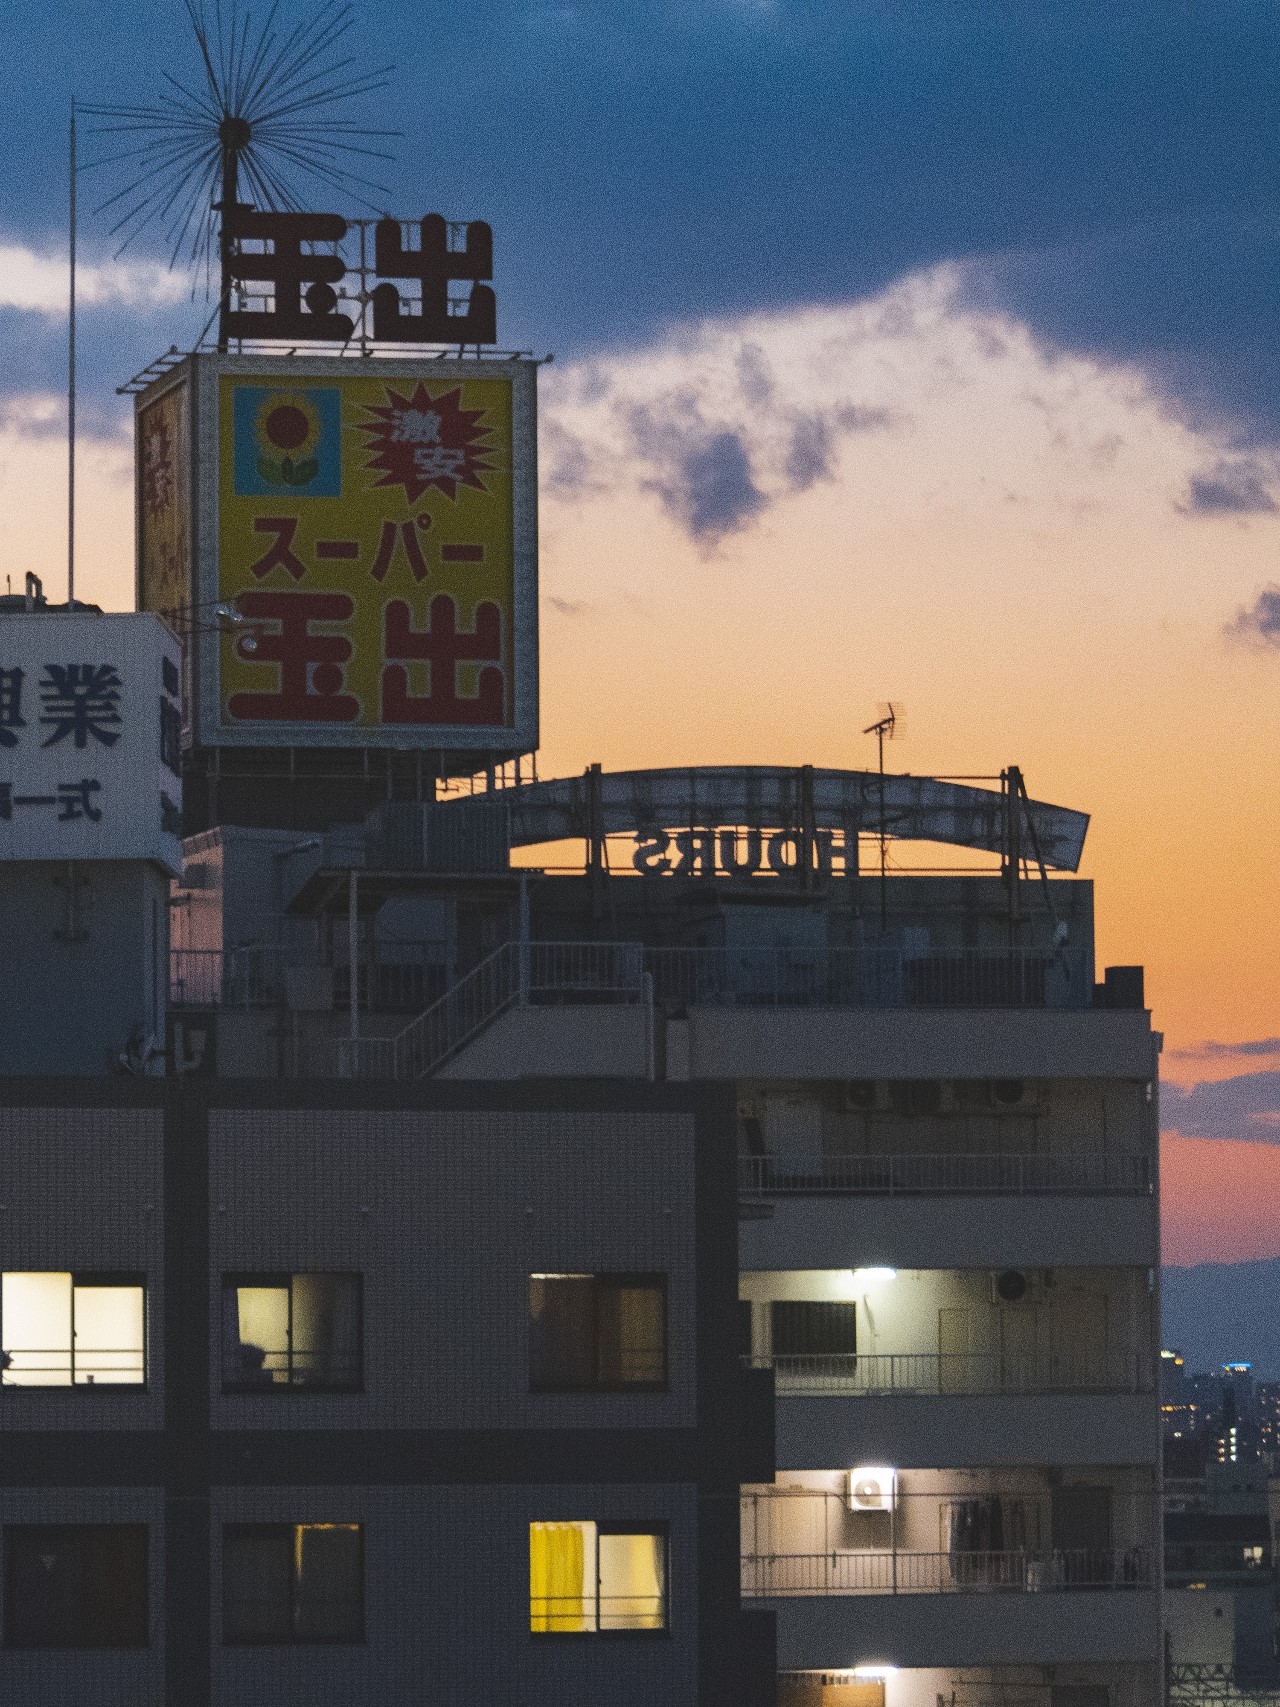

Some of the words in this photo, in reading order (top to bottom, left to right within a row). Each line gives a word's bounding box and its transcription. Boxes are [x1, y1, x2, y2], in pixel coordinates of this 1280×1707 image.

[223, 213, 497, 343] 玉出
[390, 409, 466, 482] 激安
[251, 514, 485, 583] スーパー
[227, 592, 504, 724] 玉出
